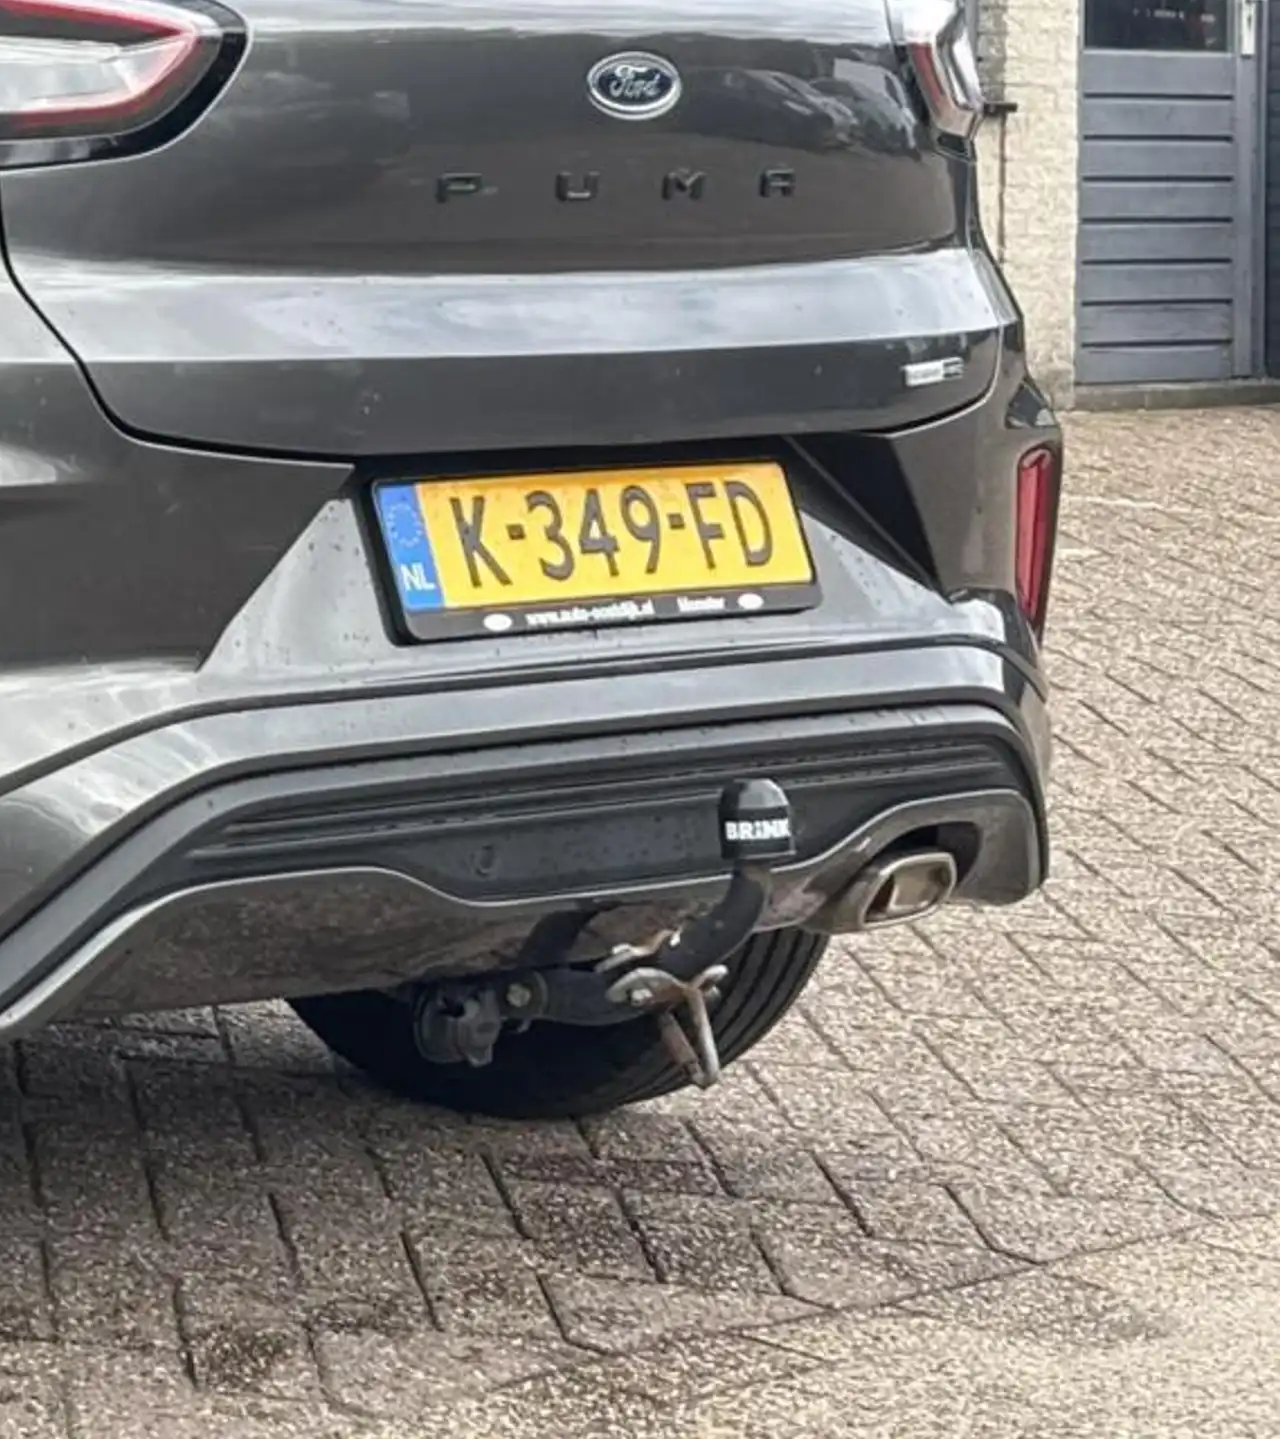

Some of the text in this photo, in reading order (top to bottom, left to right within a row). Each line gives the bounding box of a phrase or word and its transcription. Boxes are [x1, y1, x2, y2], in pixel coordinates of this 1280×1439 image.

[608, 63, 662, 99] Ford
[436, 168, 796, 203] PUMA
[449, 480, 774, 589] K-349-FD
[401, 563, 435, 592] NL
